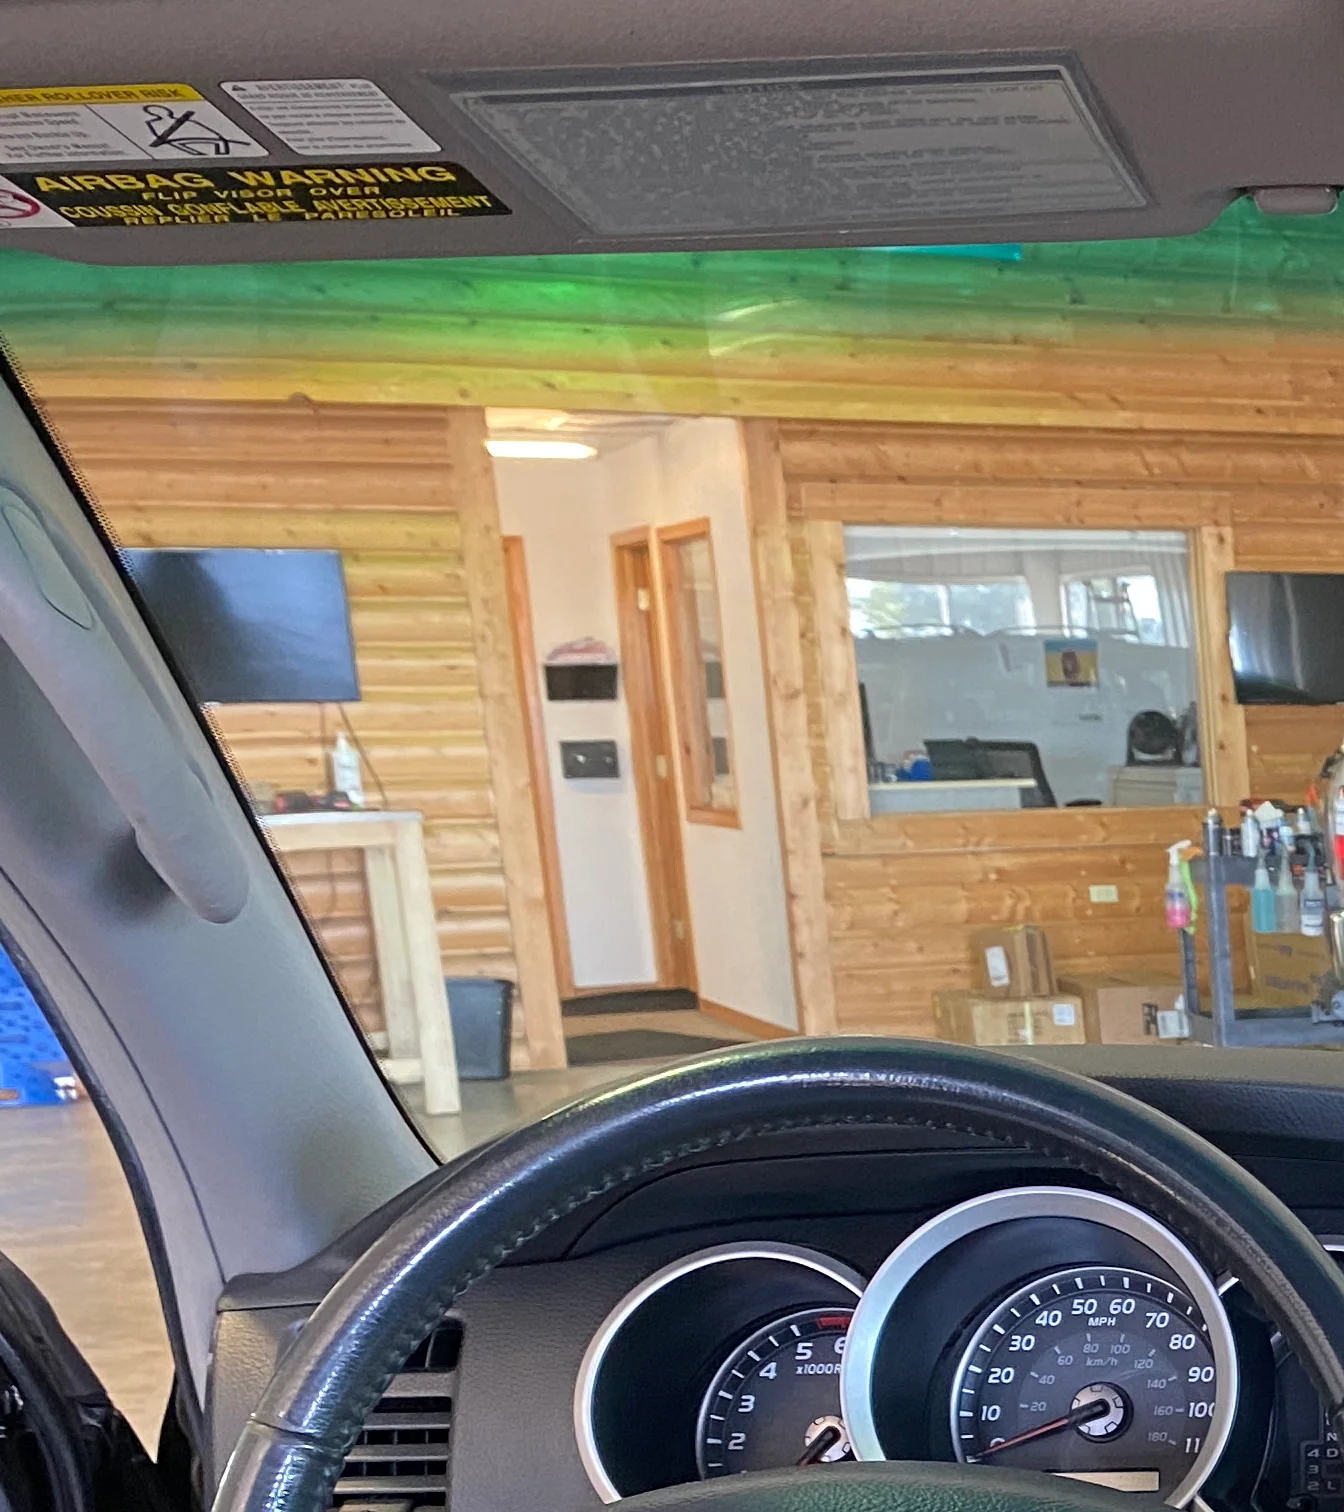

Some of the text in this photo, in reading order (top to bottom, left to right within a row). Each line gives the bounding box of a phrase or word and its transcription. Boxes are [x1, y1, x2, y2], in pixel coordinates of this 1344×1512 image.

[34, 166, 457, 193] AIRBAG WARNING
[142, 186, 380, 201] FLIP VISOR OVER
[60, 203, 163, 219] COUSSIN
[312, 195, 492, 212] AVERTISSEMENT
[1071, 1299, 1098, 1315] 50
[1108, 1298, 1136, 1314] 60
[1035, 1310, 1063, 1326] 40
[1088, 1317, 1116, 1327] MPH
[1145, 1312, 1170, 1328] 70
[1008, 1335, 1036, 1351] 30
[1083, 1344, 1099, 1354] 80
[1110, 1344, 1131, 1354] 100
[1169, 1334, 1197, 1350] 80
[795, 1342, 813, 1360] 5
[1057, 1355, 1073, 1366] 60
[1085, 1356, 1118, 1367] km/h
[1134, 1359, 1153, 1370] 120
[758, 1362, 777, 1380] 4
[988, 1367, 1015, 1384] 20
[1188, 1366, 1214, 1382] 90
[1038, 1375, 1056, 1385] 40
[1147, 1379, 1167, 1389] 140
[738, 1394, 756, 1413] 3
[1030, 1402, 1047, 1412] 20
[1153, 1406, 1174, 1416] 160
[981, 1405, 1001, 1421] 10
[728, 1432, 746, 1451] 2
[1147, 1432, 1167, 1442] 180
[1326, 1432, 1339, 1442] N
[1307, 1448, 1339, 1458] 4 D
[1307, 1464, 1320, 1475] 3
[1307, 1480, 1337, 1491] 2 L
